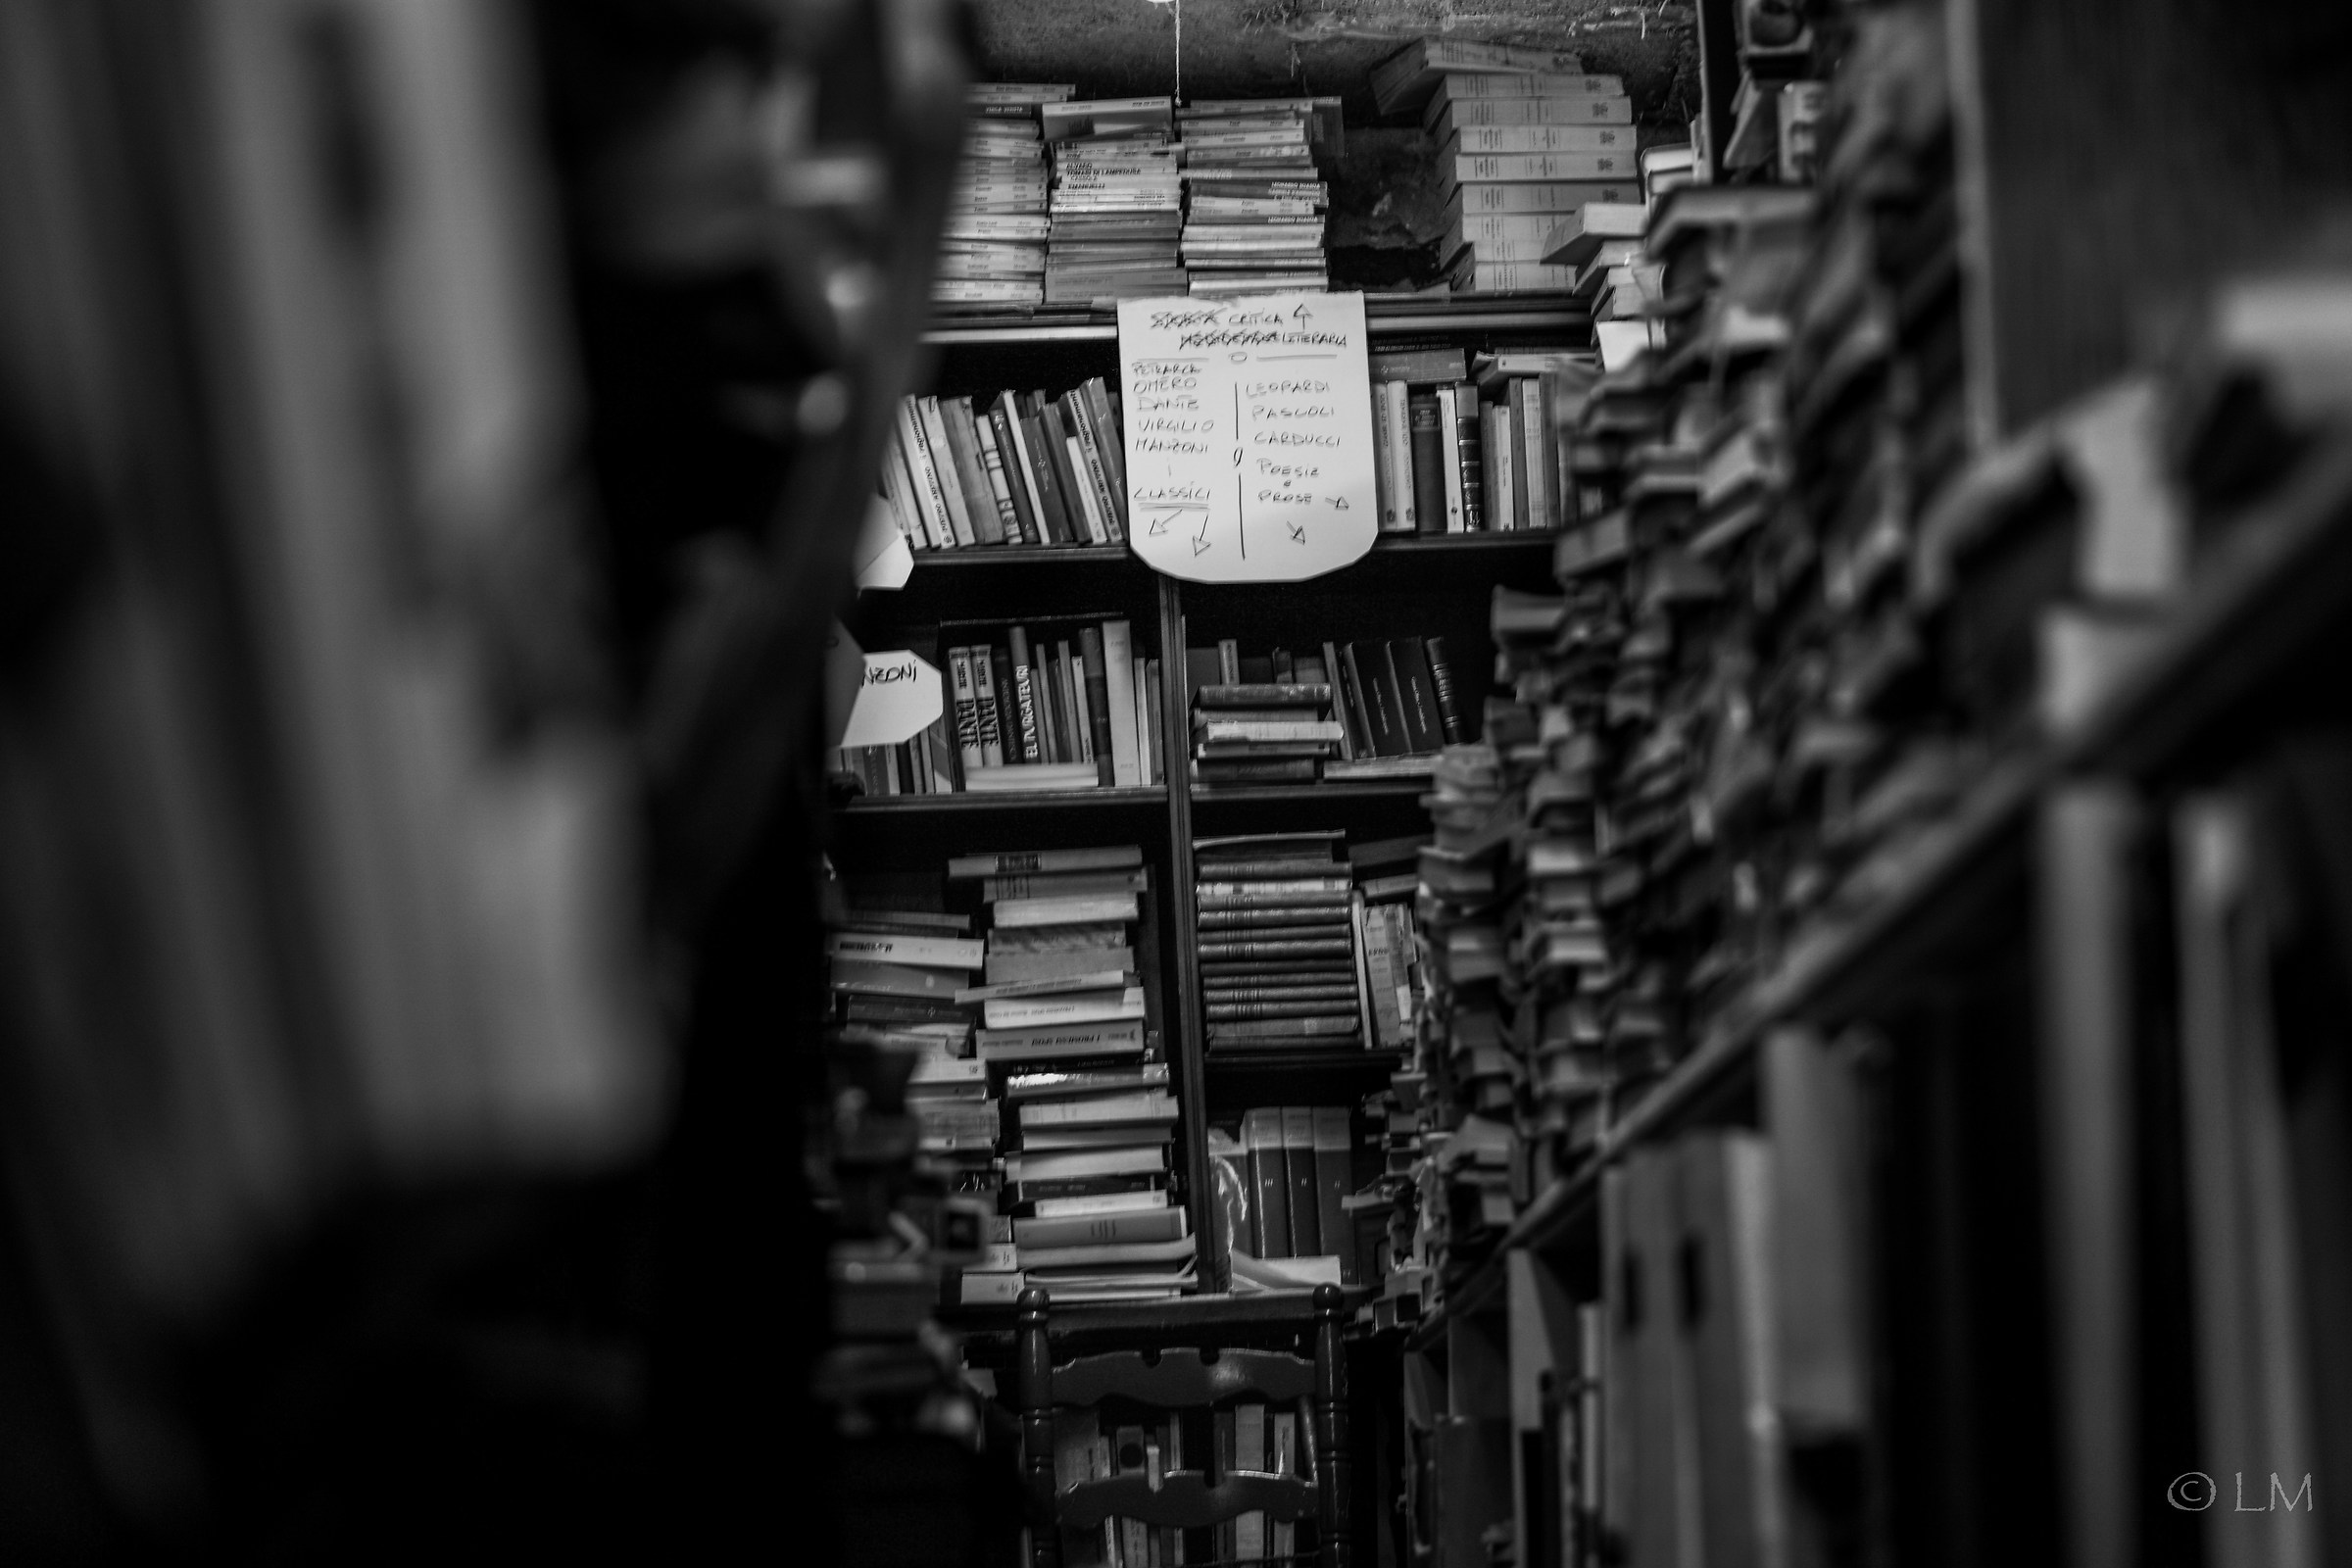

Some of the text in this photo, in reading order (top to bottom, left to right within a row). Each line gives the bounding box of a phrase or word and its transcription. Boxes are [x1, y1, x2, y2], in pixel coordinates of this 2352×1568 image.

[1133, 376, 1197, 394] OMERO
[1246, 379, 1330, 398] LEOPARDI
[1137, 395, 1200, 412] DANTE
[1251, 405, 1335, 420] PASCOLI
[1138, 416, 1214, 434] VIRGILIO
[1135, 437, 1208, 454] MANZONI
[1253, 431, 1341, 447] CARDUCCI
[1133, 480, 1211, 501] CLASSICI
[956, 697, 981, 749] DANTE
[976, 696, 1000, 748] DANTE
